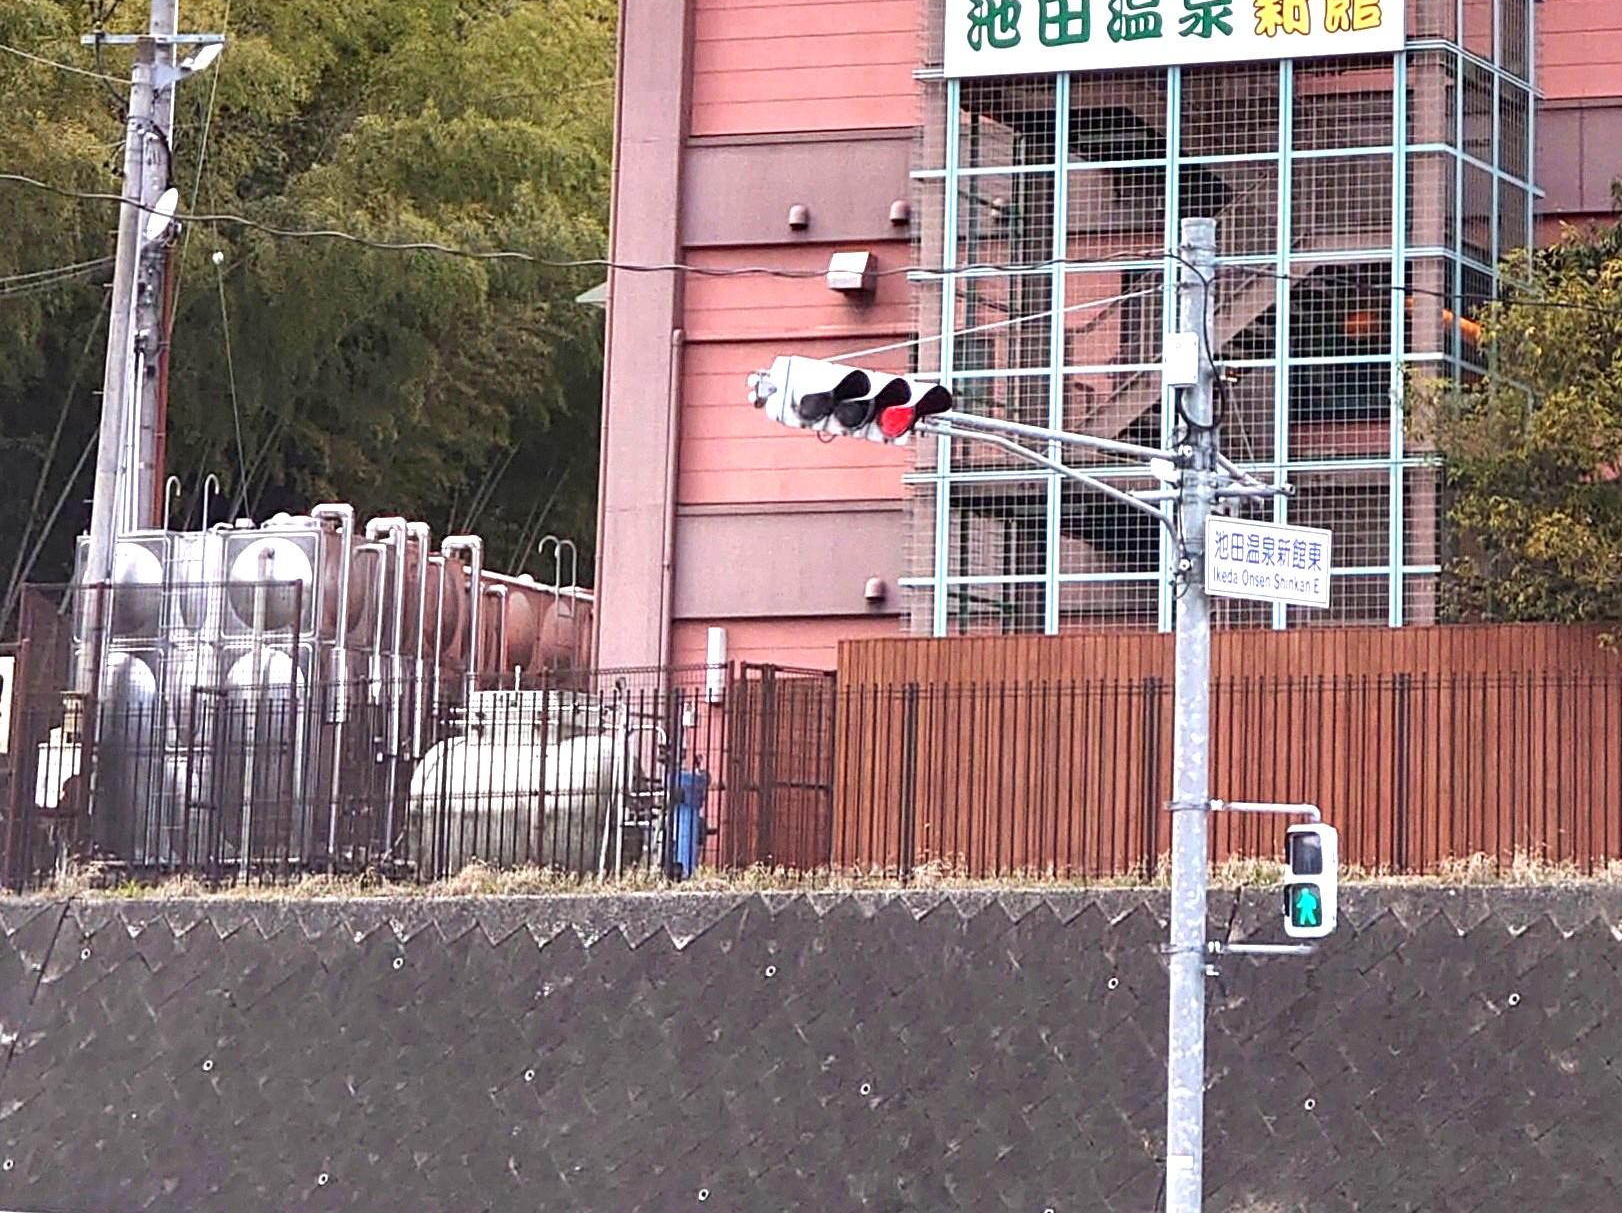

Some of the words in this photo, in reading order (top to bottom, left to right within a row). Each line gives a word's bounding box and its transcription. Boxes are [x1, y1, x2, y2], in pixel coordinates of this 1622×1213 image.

[1214, 531, 1322, 571] 池田温泉新館東
[1213, 566, 1238, 584] Ikeda
[1242, 569, 1270, 588] Onsen
[1274, 573, 1310, 592] Shinkan
[1313, 578, 1320, 594] E
